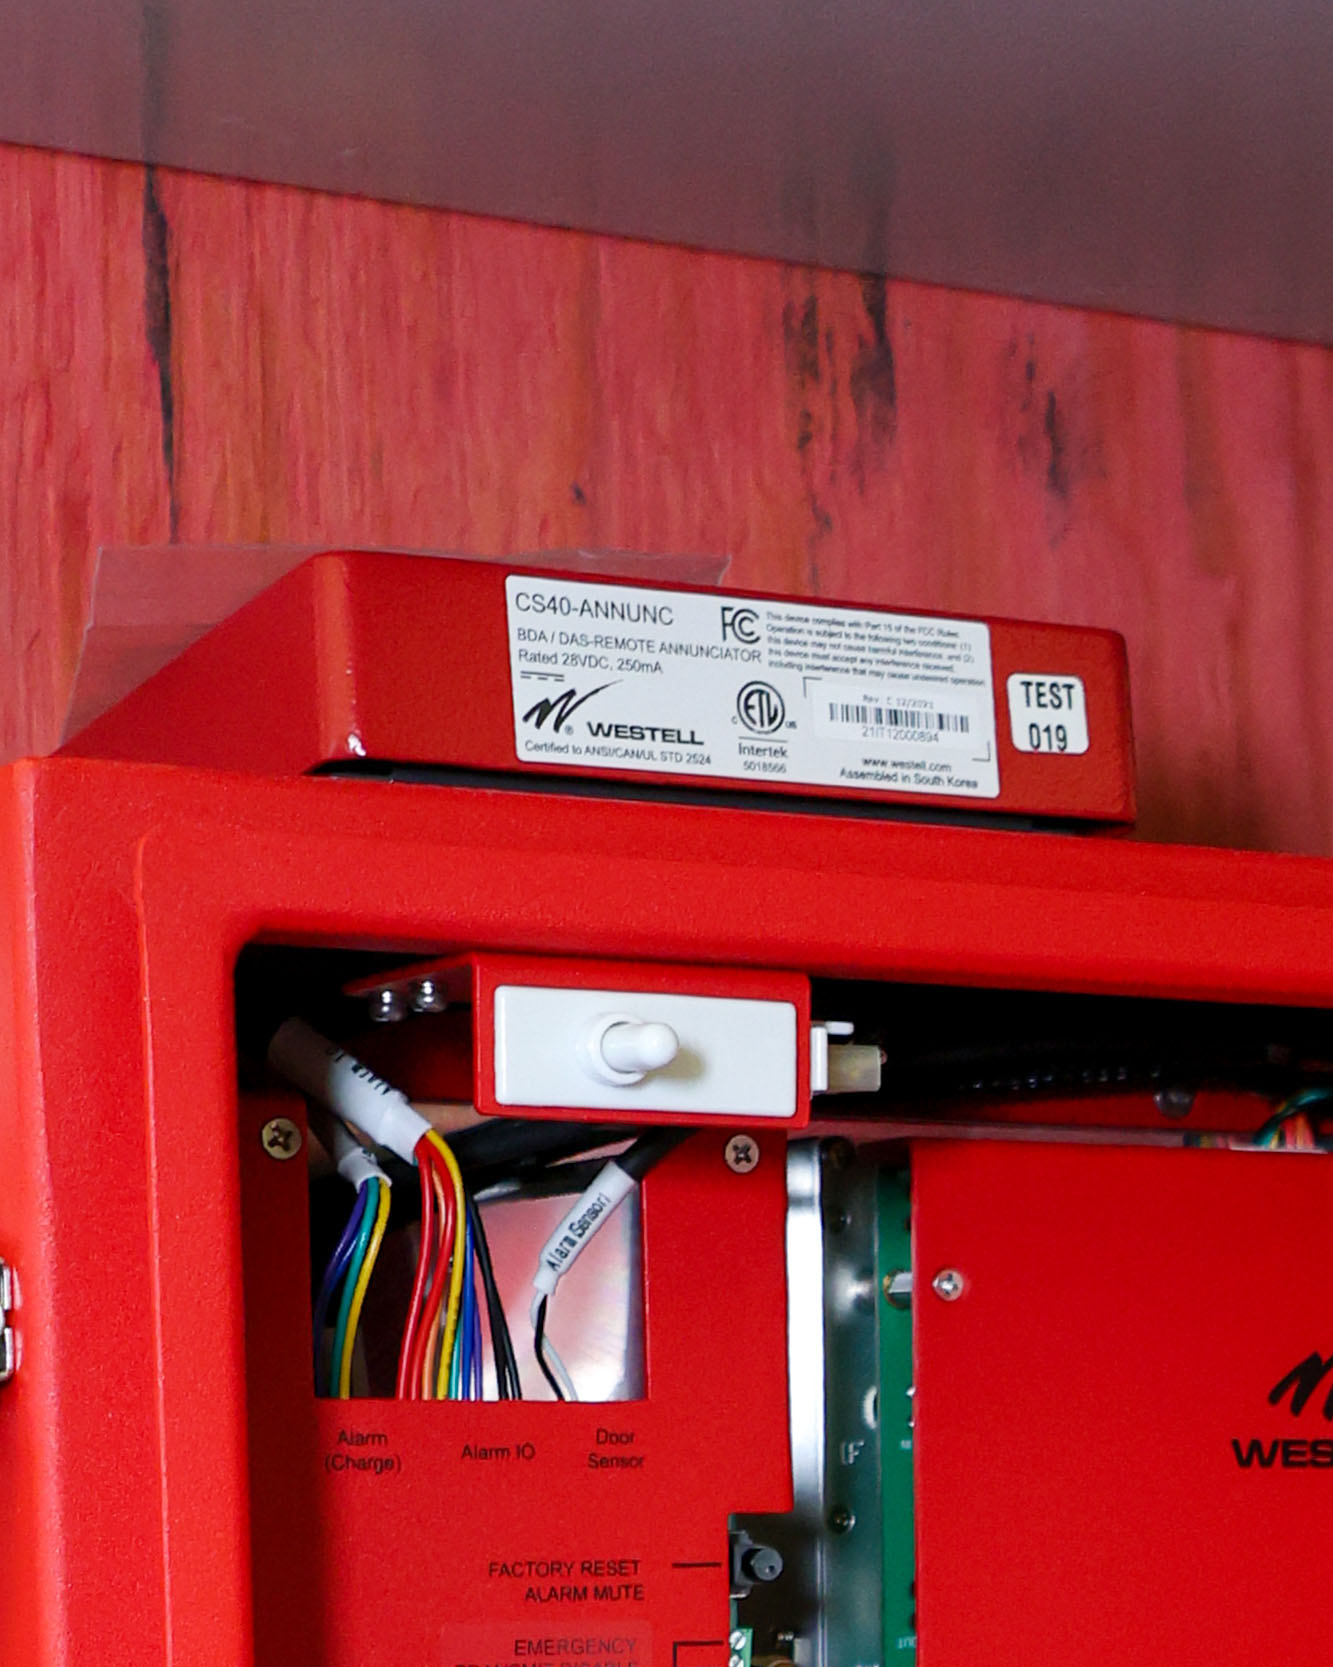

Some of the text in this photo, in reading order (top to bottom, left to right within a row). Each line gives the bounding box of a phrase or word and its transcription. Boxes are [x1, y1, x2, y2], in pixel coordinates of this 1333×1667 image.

[515, 592, 674, 626] CS40-ANNUNC
[517, 627, 762, 663] BDA DAS-REMOTE ANNUNCIATOR
[518, 649, 663, 674] Rated 28VDC, 250mA
[1020, 680, 1076, 710] TEST
[587, 721, 704, 746] WESTELL
[1028, 722, 1069, 752] 019
[524, 740, 569, 756] Certified
[572, 744, 582, 755] to
[660, 750, 682, 764] STD
[686, 752, 712, 766] 2524
[738, 742, 788, 759] Intertek
[839, 767, 898, 784] Assembled
[913, 772, 945, 787] South
[947, 775, 978, 790] Korea
[337, 1428, 388, 1446] Alarm
[596, 1428, 635, 1446] Door
[461, 1442, 536, 1460] Alarm IO
[587, 1453, 644, 1469] Sensor
[324, 1453, 402, 1475] (Charge)
[488, 1559, 641, 1579] FACTORY RESET
[525, 1584, 645, 1602] ALARM MUTE
[514, 1637, 638, 1657] EMERGENCY
